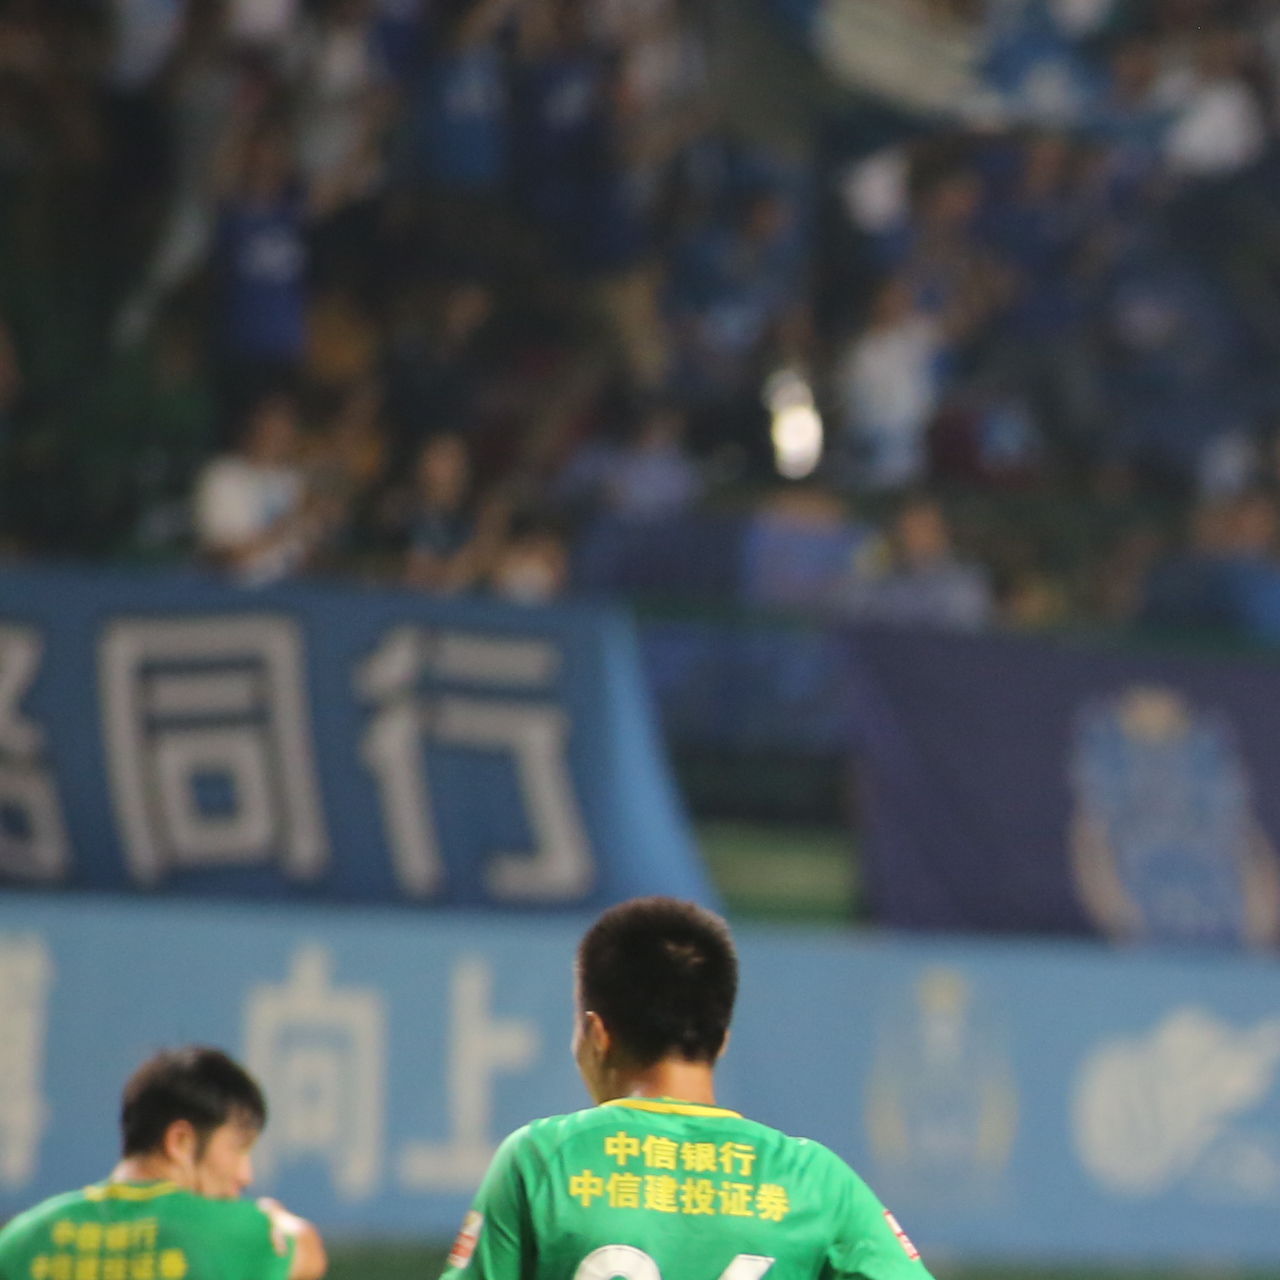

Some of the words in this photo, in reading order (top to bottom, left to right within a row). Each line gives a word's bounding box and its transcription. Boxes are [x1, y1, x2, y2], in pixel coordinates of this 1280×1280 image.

[604, 1130, 756, 1177] 中信银行
[569, 1169, 790, 1222] 中信建投证券
